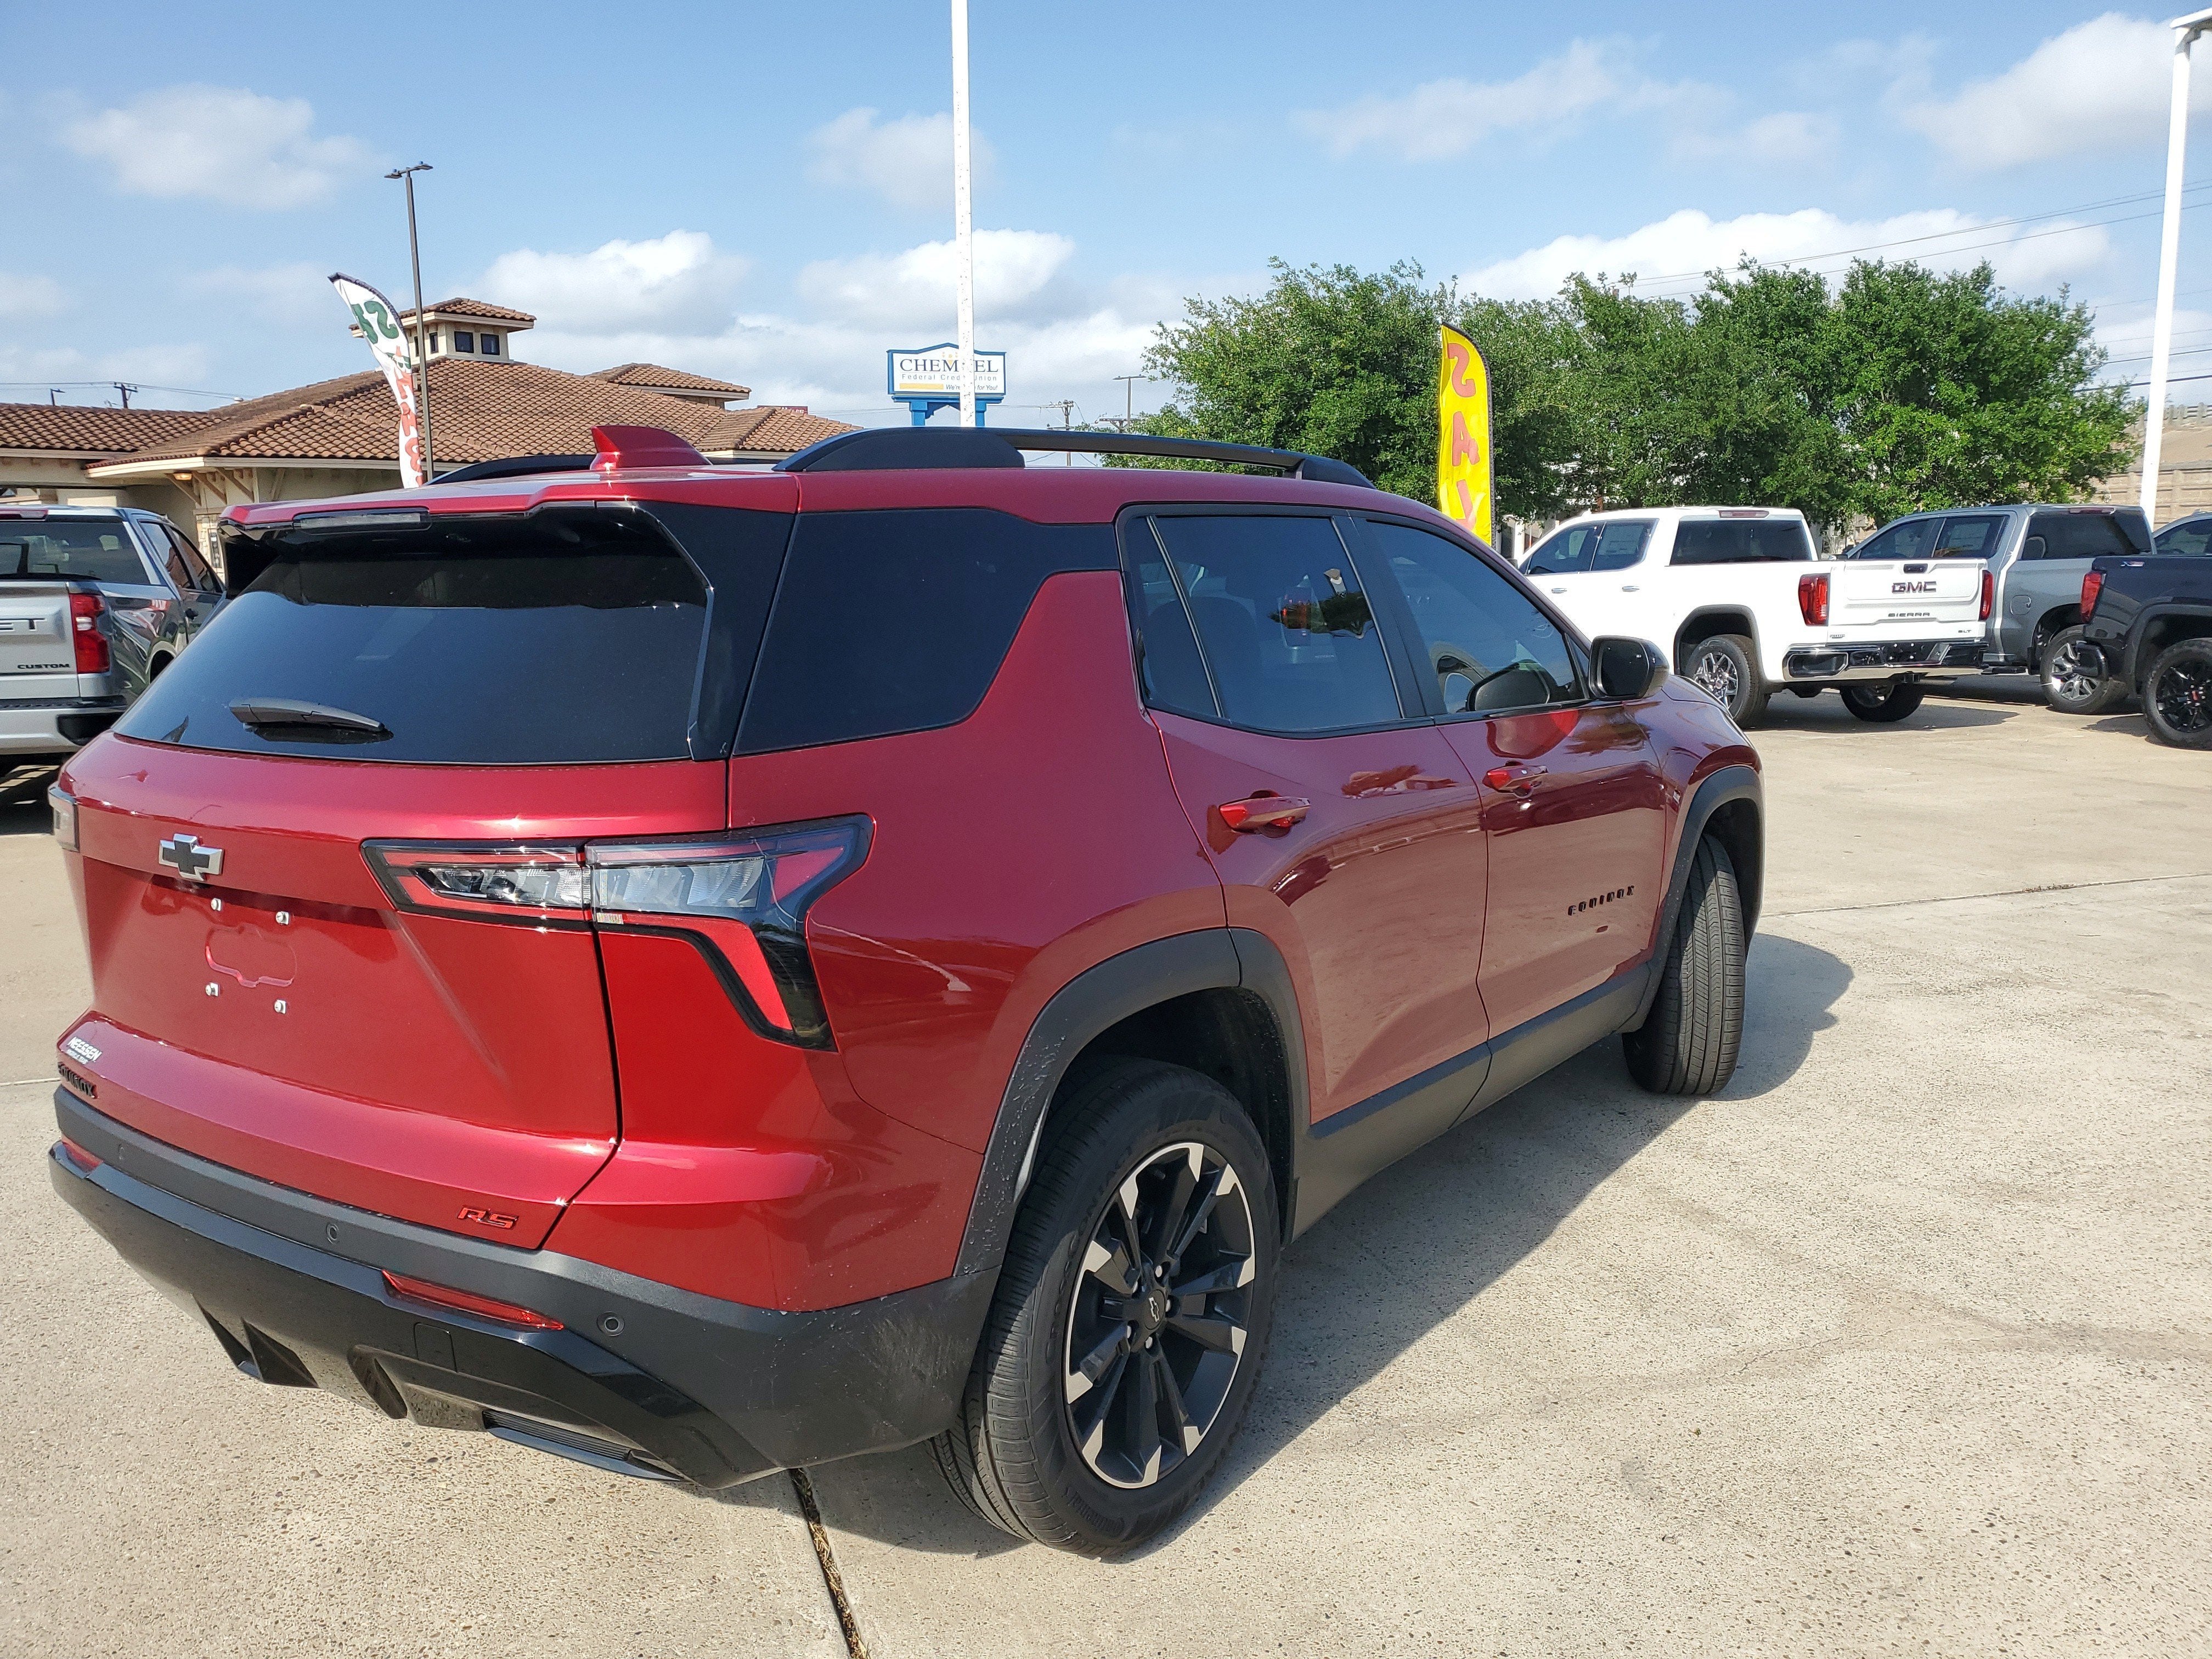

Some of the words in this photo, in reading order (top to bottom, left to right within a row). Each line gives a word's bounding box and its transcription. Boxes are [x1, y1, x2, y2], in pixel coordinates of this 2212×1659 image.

[900, 359, 998, 373] CHEMEL
[1892, 581, 1937, 594] GMC
[1567, 885, 1635, 916] EQUINOX
[457, 1206, 520, 1229] RS
